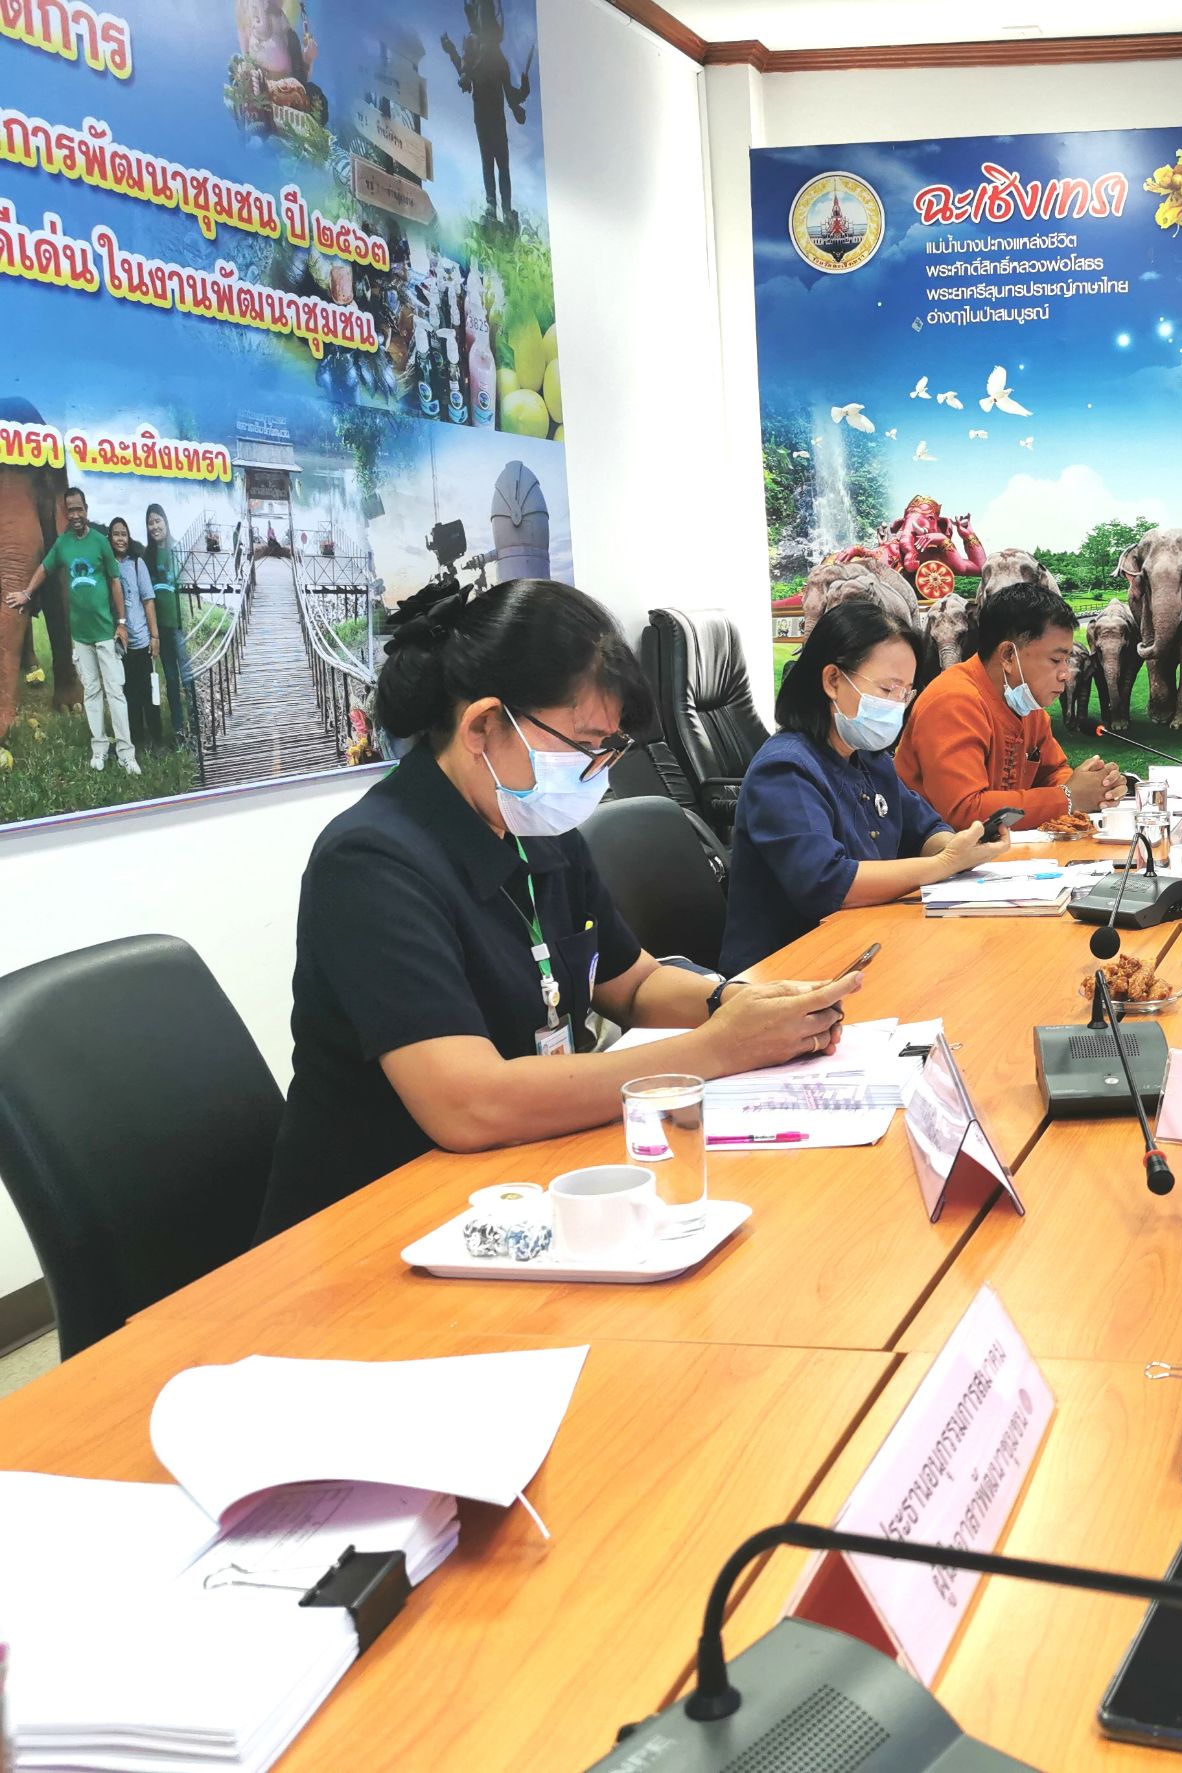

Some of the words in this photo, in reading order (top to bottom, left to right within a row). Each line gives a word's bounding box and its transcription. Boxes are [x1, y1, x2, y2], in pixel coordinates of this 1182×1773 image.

[2, 117, 278, 234] การพัฒนาชุมชน
[282, 188, 308, 243] ปี
[314, 215, 388, 267] ๒๕๖๓
[914, 162, 1128, 225] ฉะเชิงเทรา
[925, 232, 1077, 254] แม่น้ำบางปะกงแหล่งชีวิต
[96, 231, 377, 354] ในงานพัฒนาชุมชน
[926, 276, 1129, 302] พระยาศรีสุนทรปราชญ์ภาษาไทย
[69, 429, 229, 476] จ.ฉะเชิงเทรา
